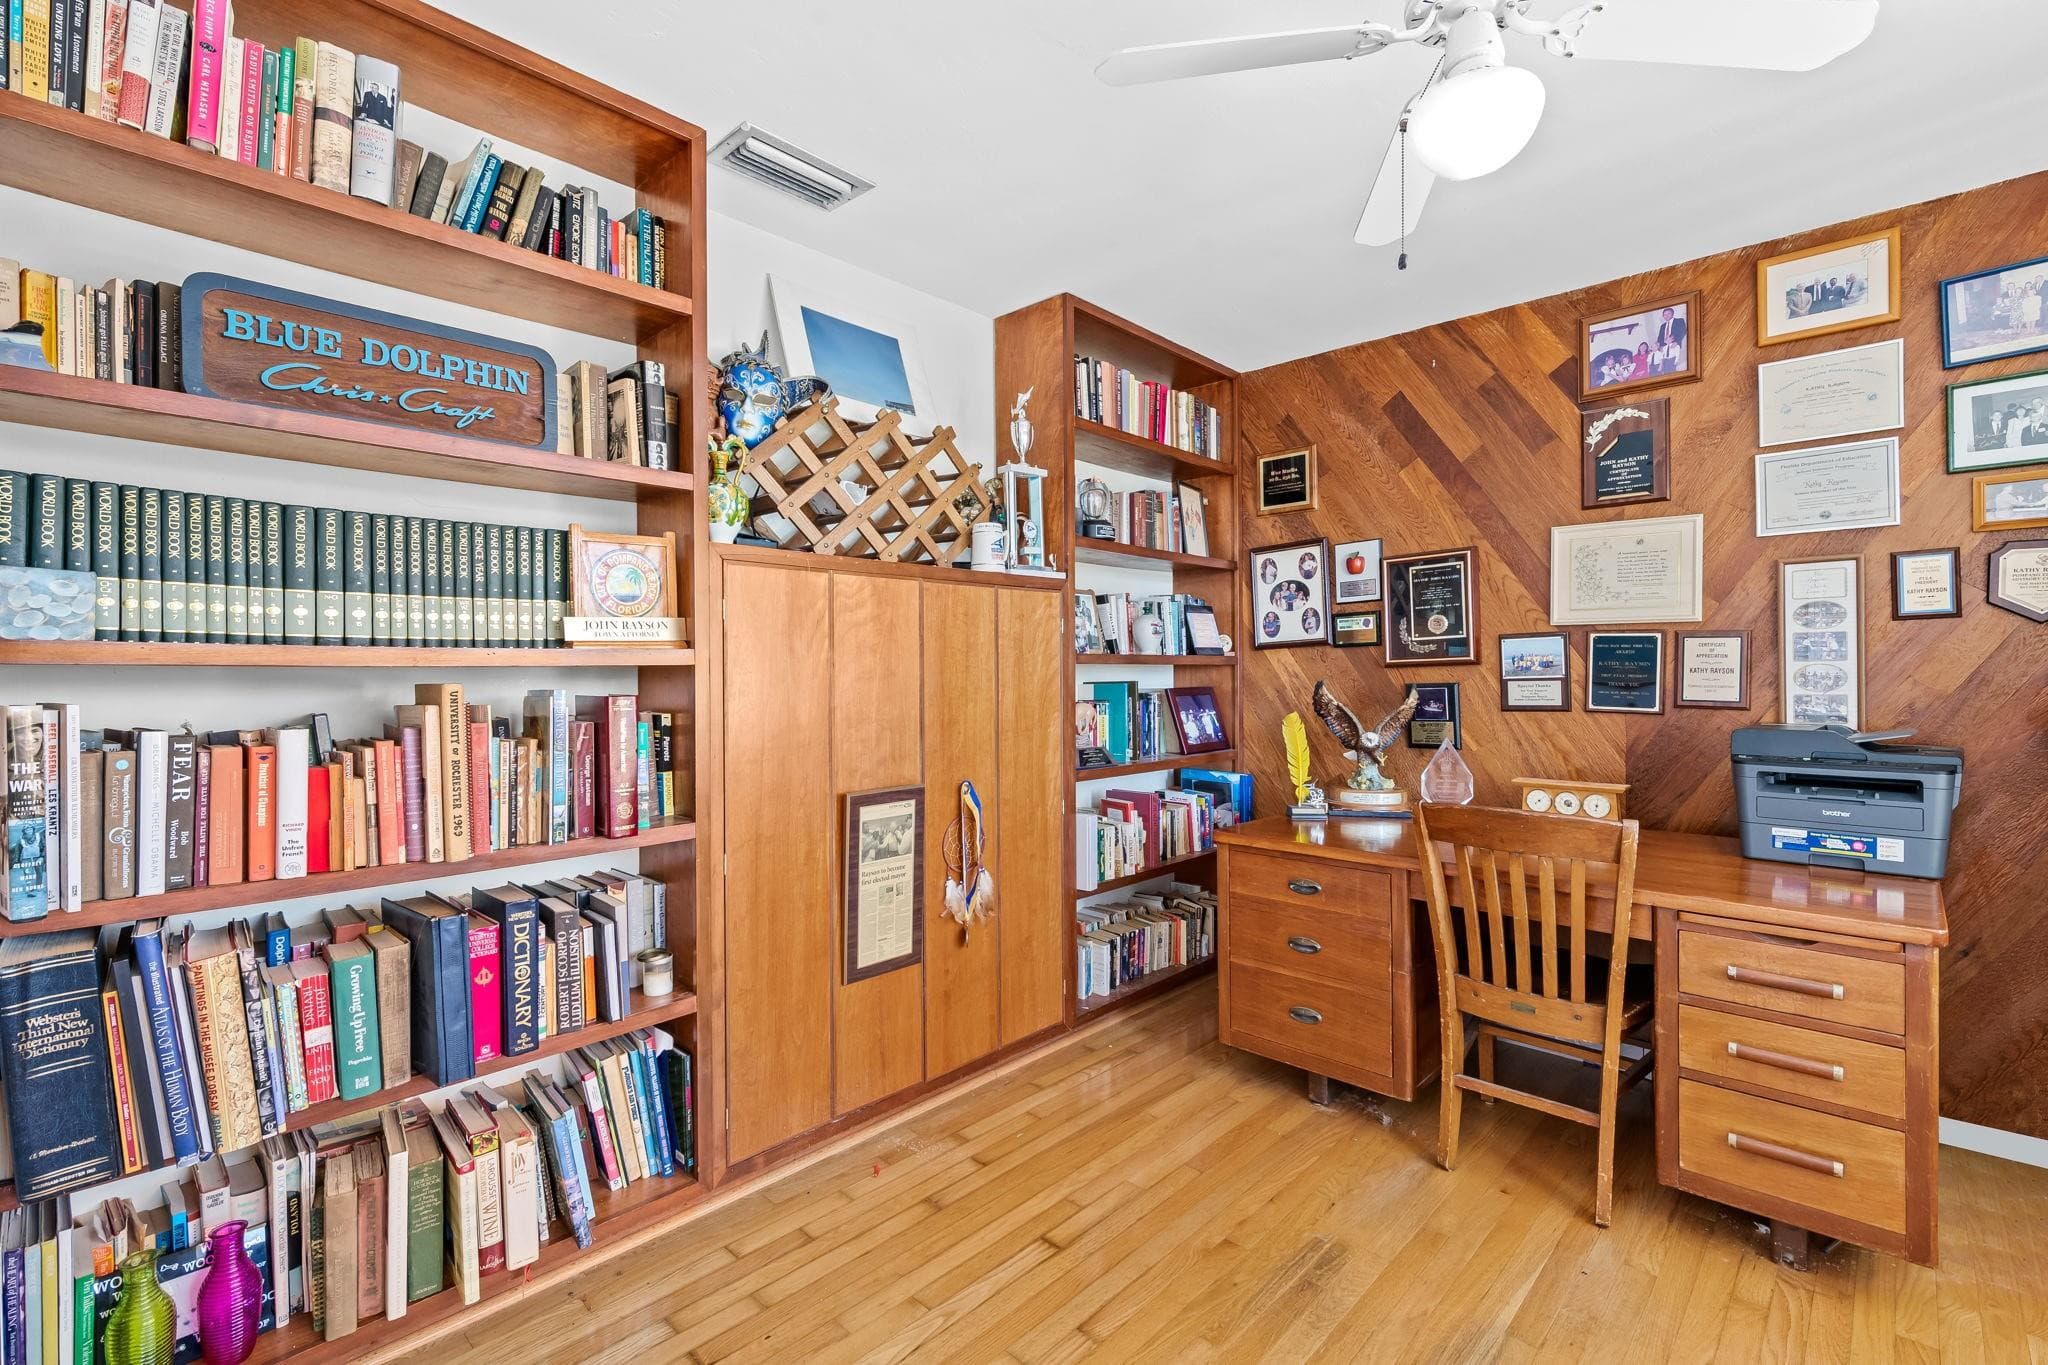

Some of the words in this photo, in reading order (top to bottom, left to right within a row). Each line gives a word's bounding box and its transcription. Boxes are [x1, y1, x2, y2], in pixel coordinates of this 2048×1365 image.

[55, 3, 63, 40] UNDYING
[54, 41, 63, 64] LOVE
[73, 32, 82, 74] Atonement
[249, 49, 258, 75] ZADIE
[201, 57, 211, 79] CARL
[199, 81, 210, 120] HIAASEN
[248, 77, 257, 105] SMITH
[247, 116, 255, 127] ON
[243, 129, 254, 163] BEAUTY
[223, 309, 342, 358] BLUE
[361, 337, 528, 394] DOLPHIN
[261, 363, 376, 401] Chris
[398, 387, 496, 428] Craft
[1612, 461, 1636, 469] RAYSON
[0, 476, 12, 513] WORLD
[42, 480, 56, 516] WORLD
[98, 487, 112, 522] WORLD
[169, 496, 180, 529] WORLD
[211, 500, 222, 533] WORLD
[295, 509, 305, 541] WORLD
[0, 515, 11, 545] BOOK
[42, 519, 55, 547] BOOK
[98, 525, 111, 553] BOOK
[353, 515, 364, 546] WORLD
[393, 519, 404, 549] WORLD
[459, 525, 468, 554] WORLD
[475, 526, 484, 560] SCIENCE
[491, 528, 499, 548] YEAR
[535, 532, 544, 552] YEAR
[169, 532, 179, 558] BOOK
[211, 536, 221, 562] BOOK
[295, 543, 304, 568] BOOK
[553, 533, 561, 559] WORLD
[353, 548, 363, 571] BOOK
[393, 551, 403, 574] BOOK
[459, 556, 467, 578] BOOK
[475, 562, 484, 583] YEAR
[491, 550, 499, 574] BOOK
[535, 554, 544, 576] BOOK
[584, 621, 618, 631] JOHN
[622, 621, 669, 630] RAYSON
[449, 691, 461, 745] UNIVERSITY
[49, 722, 57, 743] REEL
[453, 748, 459, 756] OF
[663, 736, 671, 762] Parrots
[11, 762, 41, 775] THE
[48, 745, 57, 784] BASEBALL
[172, 742, 193, 802] FEAR
[9, 780, 44, 793] WAR
[48, 789, 57, 804] LES
[452, 760, 462, 810] ROCHESTER
[48, 804, 57, 837] KRANTZ
[453, 814, 464, 837] 1969
[1822, 809, 1851, 818] brother
[169, 819, 178, 859] Woodward
[181, 831, 189, 846] Bob
[557, 931, 568, 978] SCORPIO
[569, 929, 580, 976] ILLUSION
[150, 970, 165, 1005] illustrated
[513, 922, 532, 1027] DICTIONARY
[193, 965, 208, 1013] PAINTINGS
[314, 987, 328, 1018] JOHN
[349, 965, 364, 1013] Growing
[25, 1008, 82, 1028] Webster's
[198, 1013, 208, 1023] IN
[559, 984, 570, 1029] ROBERT
[571, 981, 581, 1027] LUDLUM
[17, 1026, 55, 1041] Third
[57, 1018, 90, 1032] New
[152, 1007, 171, 1041] ATLAS
[200, 1024, 211, 1042] THE
[350, 1011, 366, 1028] Up
[12, 1024, 95, 1053] International
[20, 1036, 90, 1060] Dictionary
[159, 1037, 174, 1051] OF
[354, 1027, 367, 1053] Free
[160, 1050, 176, 1070] THE
[202, 1043, 217, 1074] MUSÉE
[309, 1064, 332, 1076] FIND
[164, 1068, 184, 1108] HUMAN
[206, 1074, 220, 1111] D'ORSAY
[312, 1075, 331, 1085] YOU
[171, 1108, 190, 1137] BODY
[211, 1114, 224, 1149] ABRAMS
[486, 1157, 497, 1200] LAROUSSE
[290, 1197, 298, 1236] POLAND
[482, 1200, 498, 1243] WINE
[182, 1254, 215, 1272] WOO
